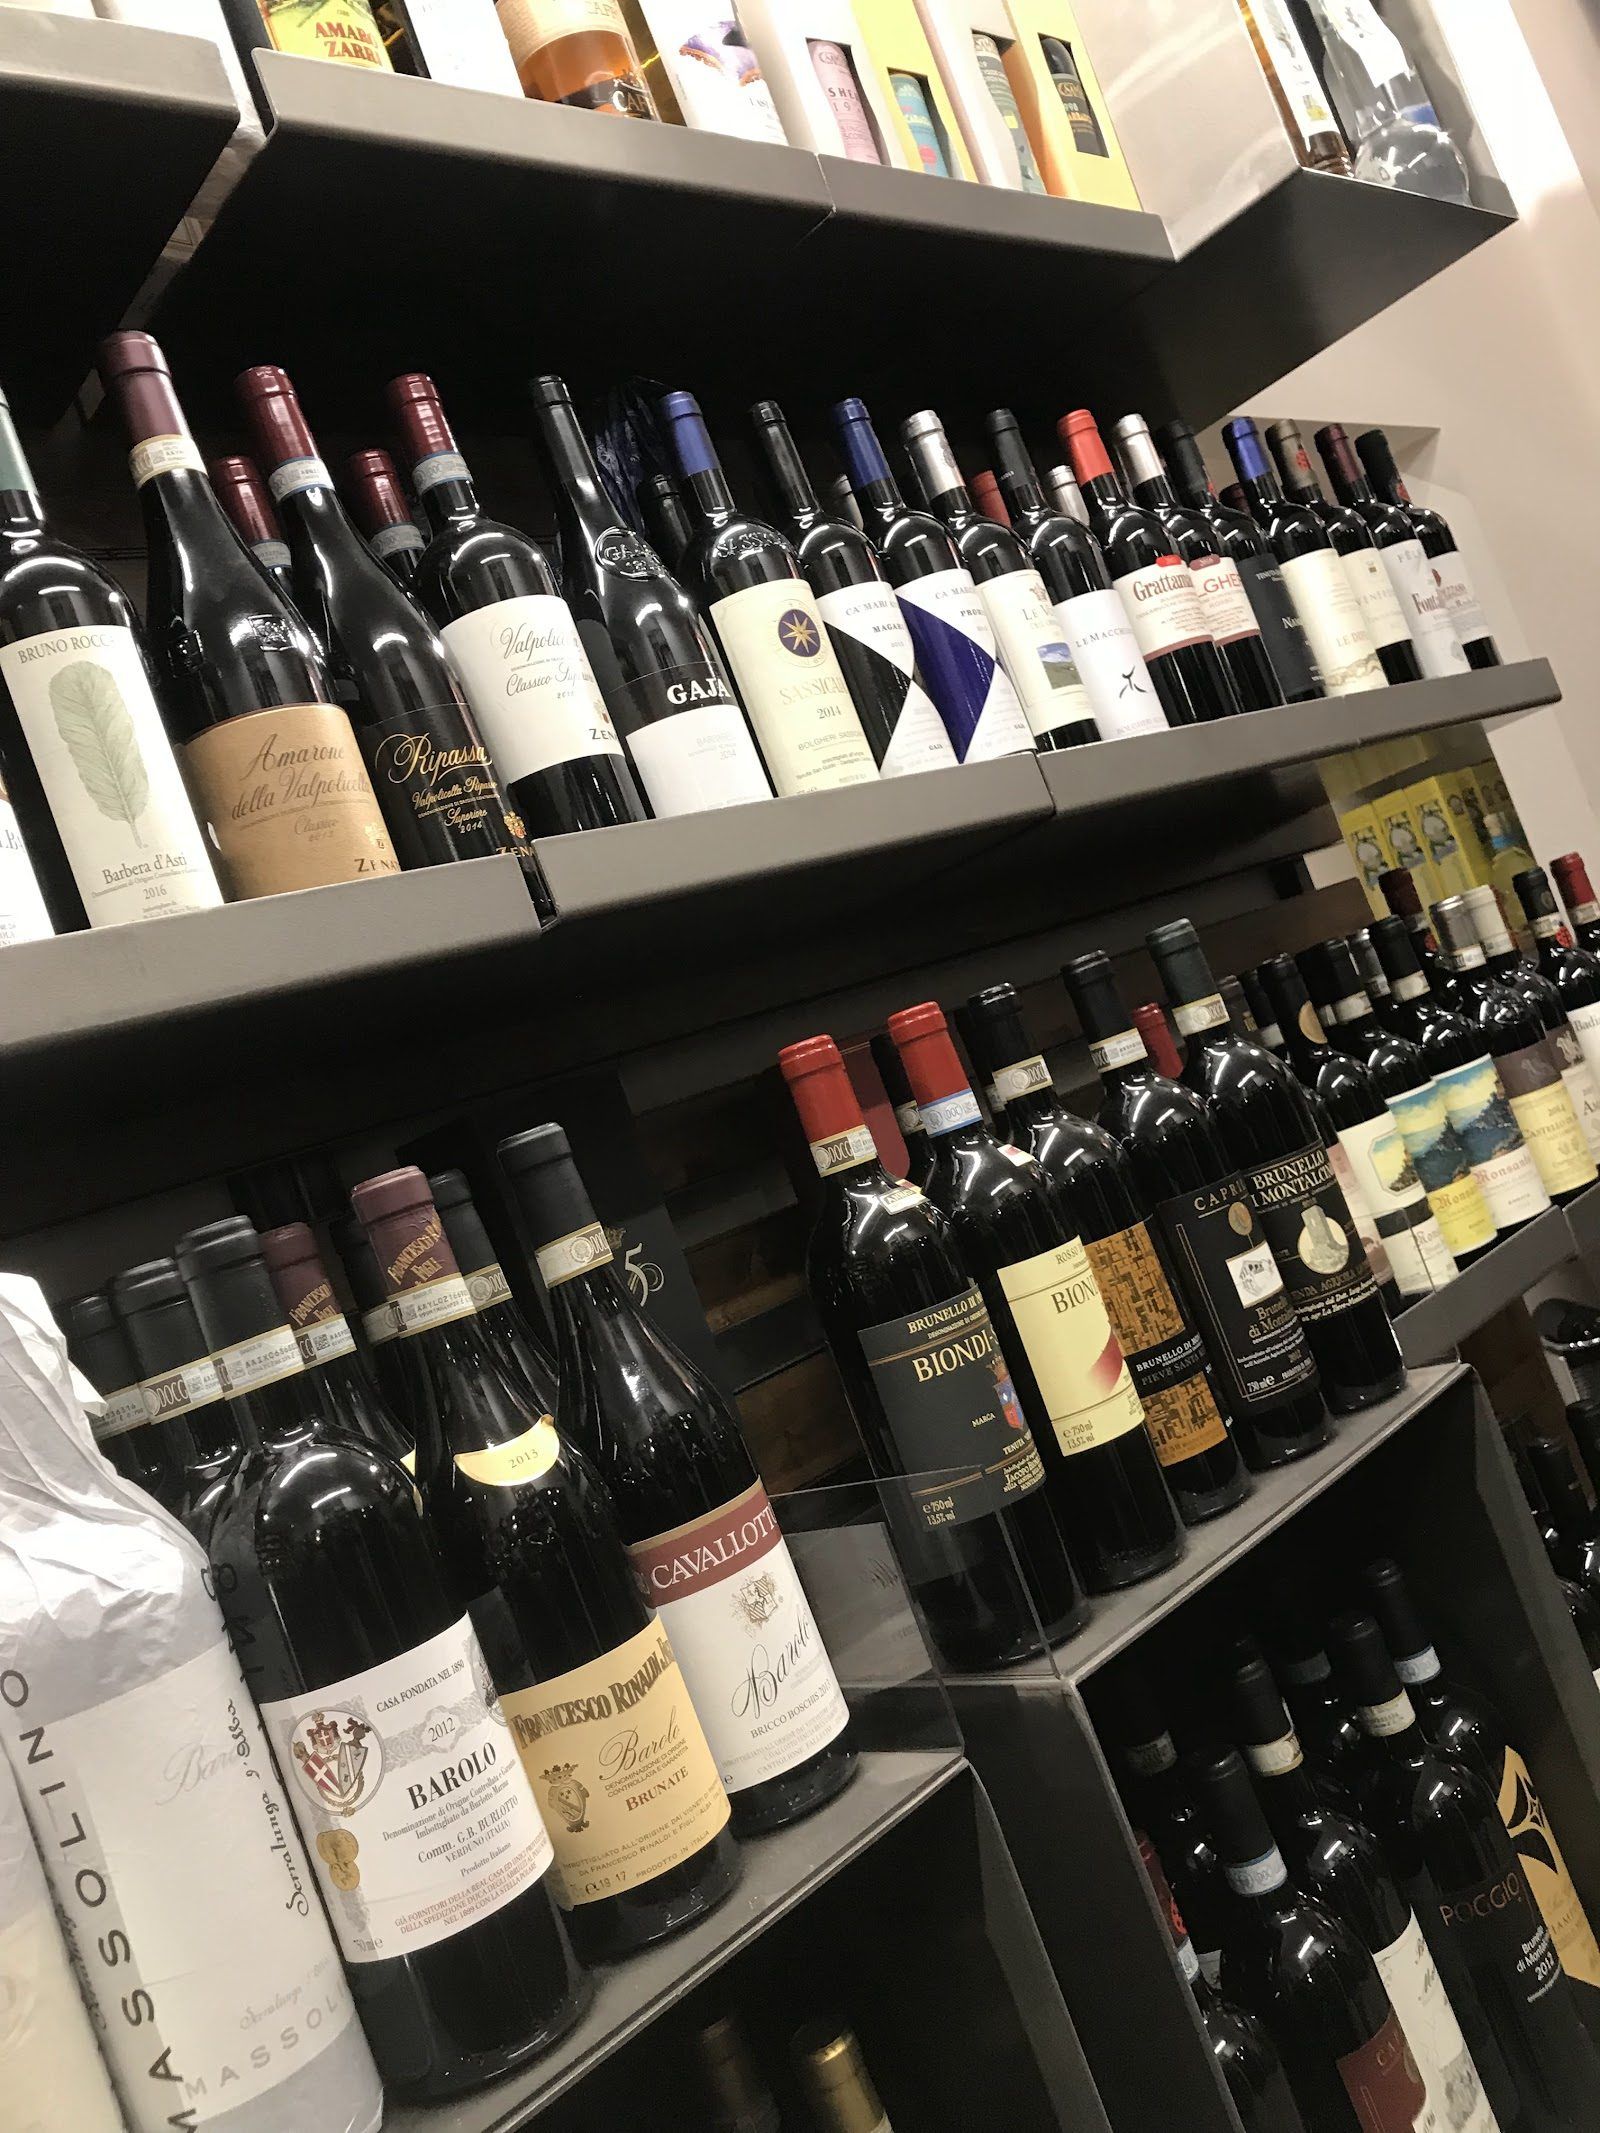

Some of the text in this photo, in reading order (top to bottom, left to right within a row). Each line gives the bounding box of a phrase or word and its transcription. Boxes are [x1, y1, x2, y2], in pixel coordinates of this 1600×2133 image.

[17, 639, 68, 665] BRUNO
[506, 673, 552, 697] Classico
[667, 678, 732, 705] GAJA
[240, 733, 344, 781] Amarone
[375, 732, 492, 786] Ripassa
[231, 784, 274, 820] della
[102, 862, 151, 884] Barbera
[143, 885, 167, 899] 2016
[1251, 1150, 1325, 1189] BRUNELLO
[907, 1300, 968, 1334] BRUNELLO
[1248, 1325, 1260, 1338] di
[1136, 1346, 1184, 1372] BRUNELLO
[971, 1412, 996, 1428] MARCA
[508, 1447, 540, 1470] 2013
[376, 1696, 400, 1713] CASA
[400, 1677, 438, 1703] FONDATA
[438, 1667, 453, 1684] NEL
[511, 1694, 613, 1749] FRANCESCO
[608, 1651, 662, 1714] RINALDI
[428, 1716, 456, 1743] 2012
[750, 1714, 787, 1739] BRICCO
[788, 1693, 820, 1720] BOSCHIS
[599, 1704, 681, 1780] Barolo
[406, 1742, 497, 1811] BAROLO
[604, 1758, 661, 1791] DENOMINAZIONE
[661, 1752, 668, 1760] DI
[607, 1769, 658, 1797] CONTROLLATA
[625, 1766, 689, 1812] BRUNATE
[382, 1811, 437, 1842] Denominazione
[437, 1805, 446, 1818] di
[445, 1793, 470, 1814] Origine
[470, 1775, 499, 1798] Controllata
[415, 1812, 461, 1840] Imbottigliato
[461, 1806, 469, 1818] da
[469, 1791, 494, 1811] Burlotto
[418, 1794, 519, 1864] Comm. G.B. BURLOTTO
[445, 1833, 485, 1863] VERDUNO
[621, 1822, 670, 1851] ALL'ORIGINE
[261, 1790, 309, 1917] Serralunga
[460, 1856, 490, 1878] Prodotto
[590, 1852, 638, 1875] FRANCESCO
[639, 1833, 671, 1854] RINALDI
[635, 1853, 679, 1879] PRODOTTO
[680, 1846, 689, 1856] IN
[400, 1919, 424, 1935] DELLA
[423, 1901, 468, 1926] SPEDIZIONE
[467, 1890, 488, 1908] DUCA
[487, 1876, 507, 1896] DEGLI
[408, 1899, 449, 1922] FORNITORI
[448, 1888, 472, 1908] DELLA
[472, 1878, 489, 1895] REAL
[488, 1866, 505, 1884] CASA
[444, 1913, 460, 1928] NEL
[475, 1896, 492, 1913] CON
[491, 1889, 501, 1902] LA
[500, 1876, 519, 1896] STELLA
[1439, 1872, 1520, 1927] POGGIO
[184, 1976, 347, 2099] MASSOLI
